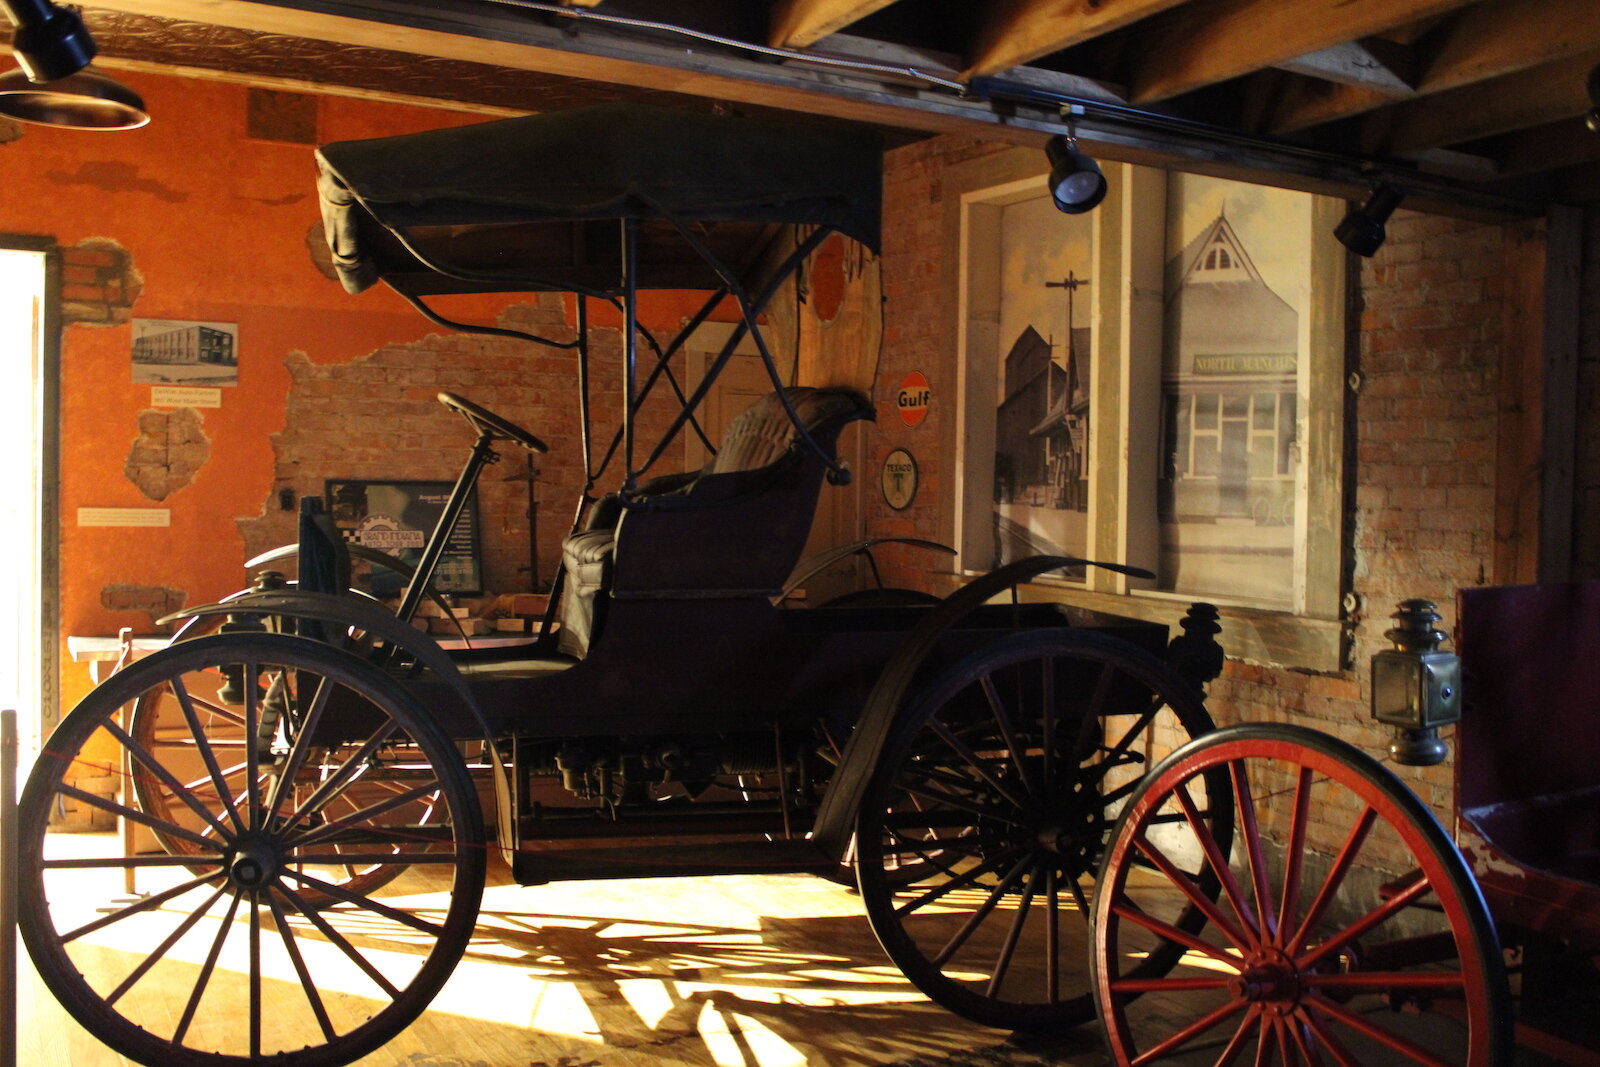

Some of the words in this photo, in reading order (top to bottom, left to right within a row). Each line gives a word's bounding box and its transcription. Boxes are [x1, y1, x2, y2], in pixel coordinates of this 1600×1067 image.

[1196, 357, 1235, 370] NORTH
[898, 391, 930, 407] Gulf
[887, 464, 912, 472] TEXACO
